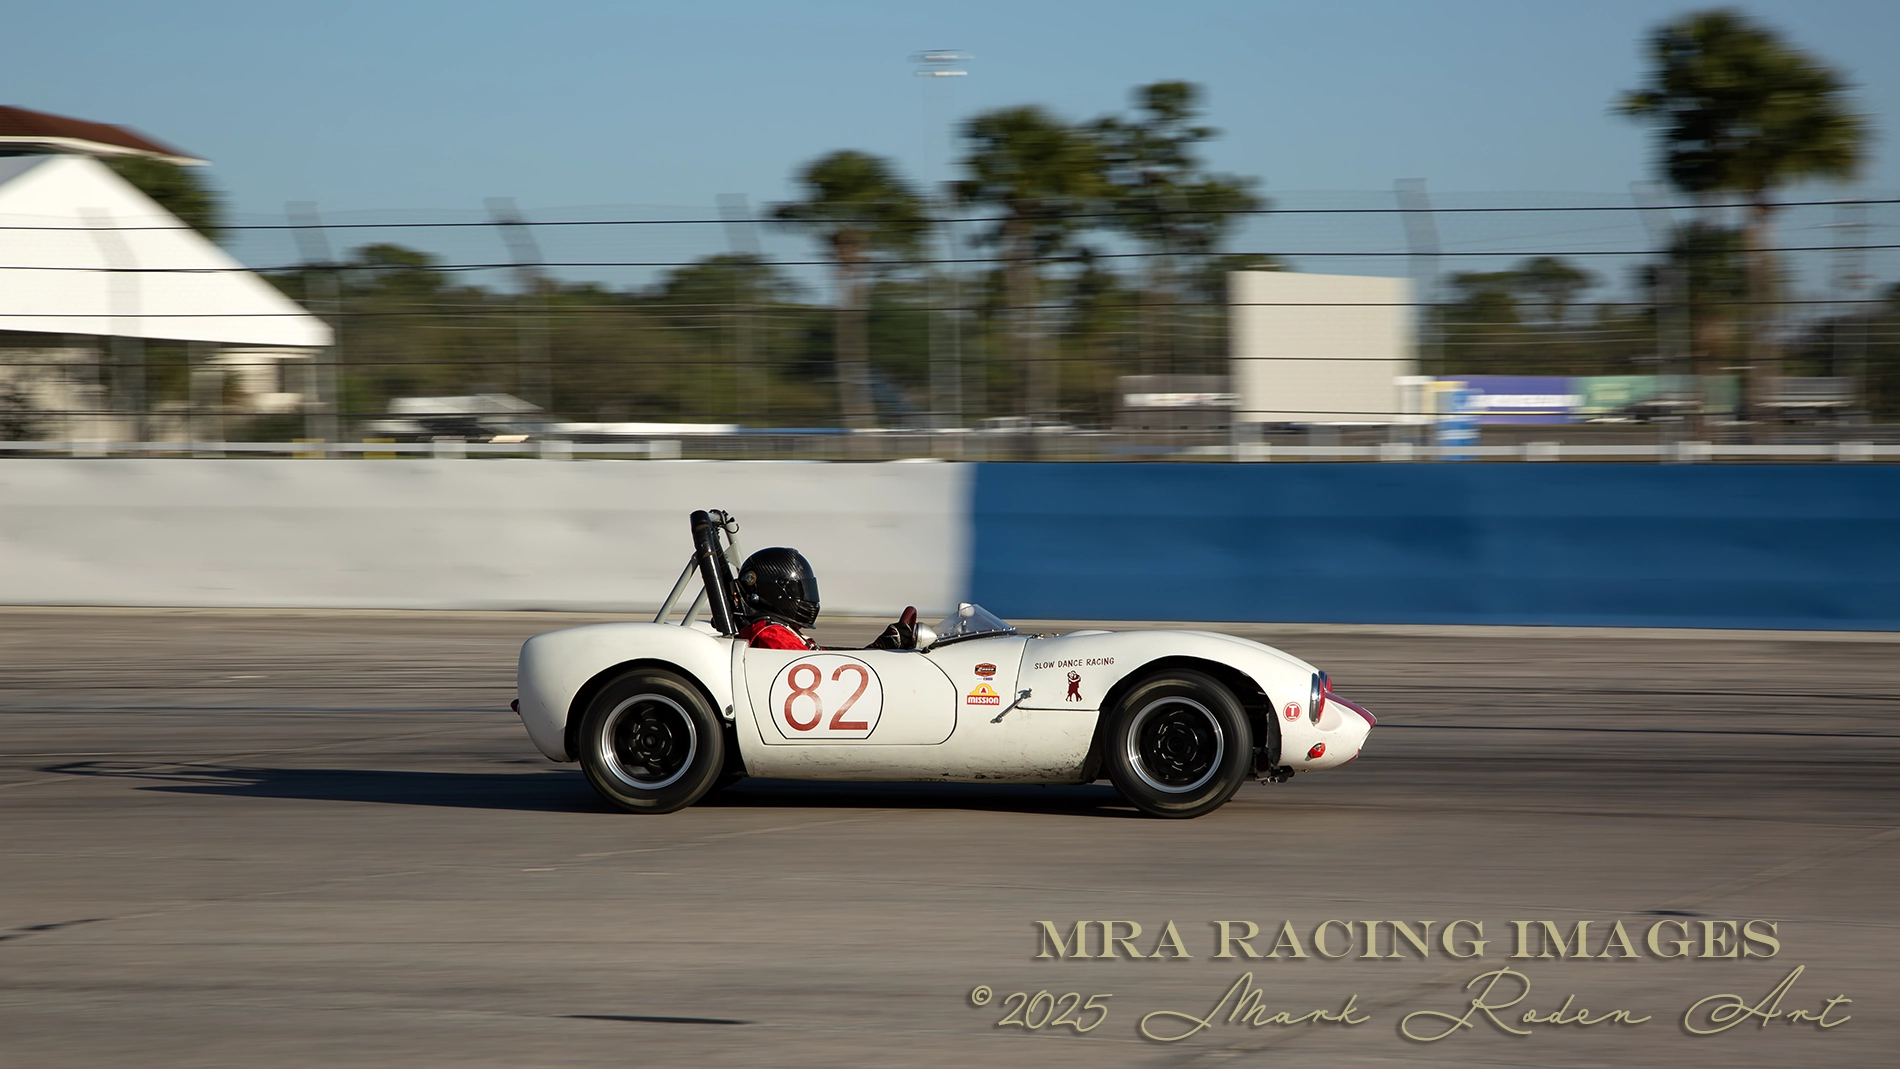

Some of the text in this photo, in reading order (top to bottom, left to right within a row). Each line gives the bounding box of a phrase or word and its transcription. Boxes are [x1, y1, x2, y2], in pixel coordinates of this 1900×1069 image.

[1034, 657, 1114, 670] SLOW DANCE RACING
[784, 663, 869, 731] 82
